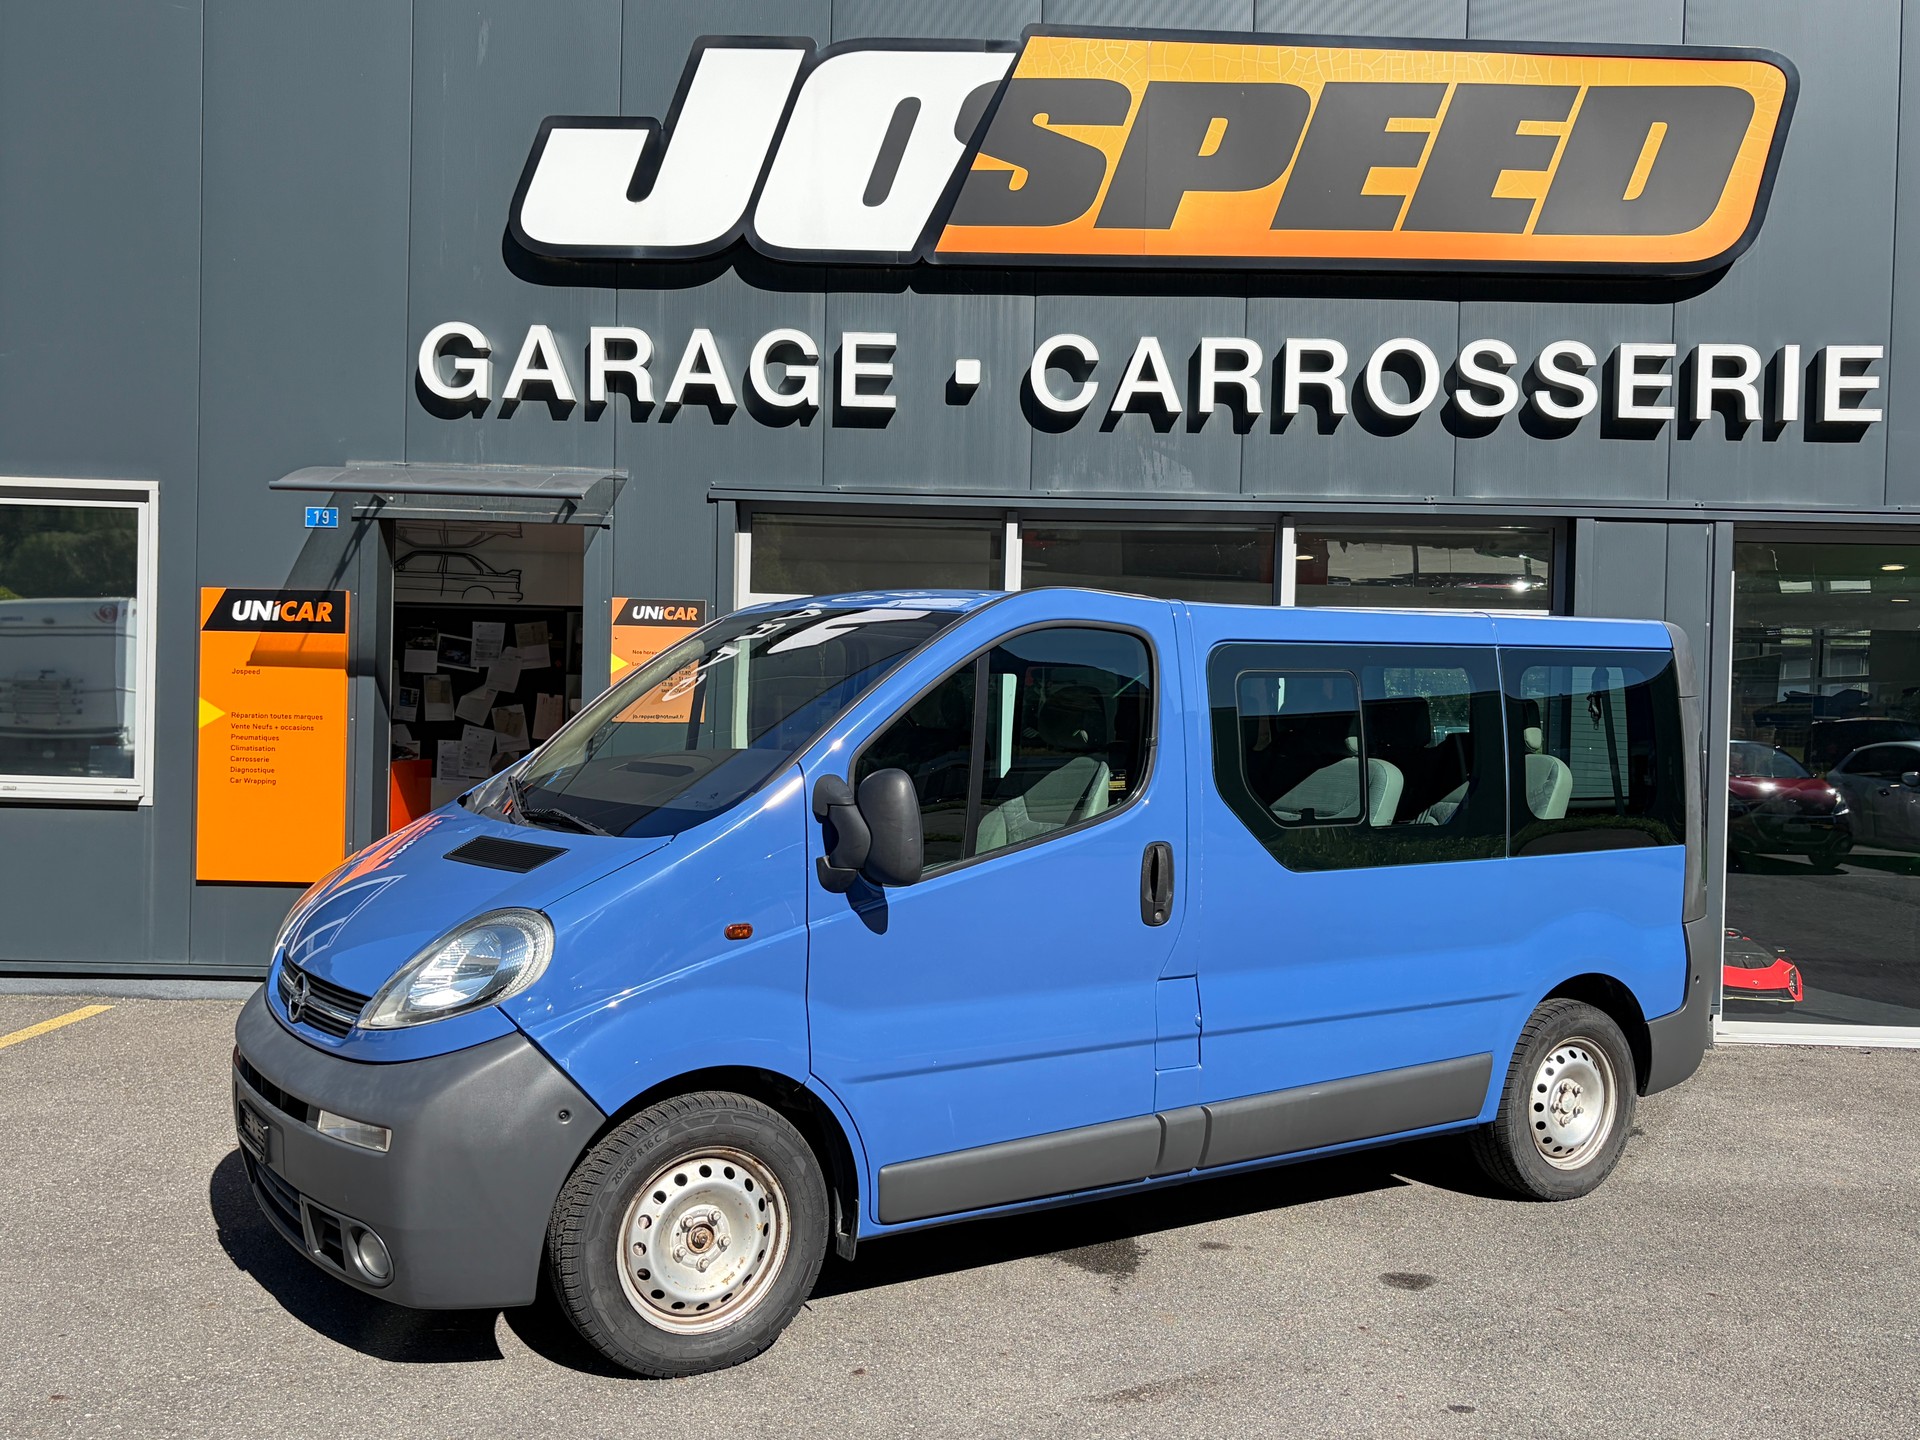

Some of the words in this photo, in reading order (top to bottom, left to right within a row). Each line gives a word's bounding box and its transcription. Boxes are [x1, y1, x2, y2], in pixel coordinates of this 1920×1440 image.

[418, 321, 897, 413] GARAGE
[1029, 333, 1883, 423] CARROSSERIE
[313, 510, 330, 525] 19
[231, 711, 269, 719] Réparation
[231, 734, 279, 742] Pneumatiques
[230, 766, 275, 774] Diagnostique
[612, 1155, 637, 1185] 205/65
[637, 1148, 645, 1156] R
[644, 1140, 654, 1150] 16
